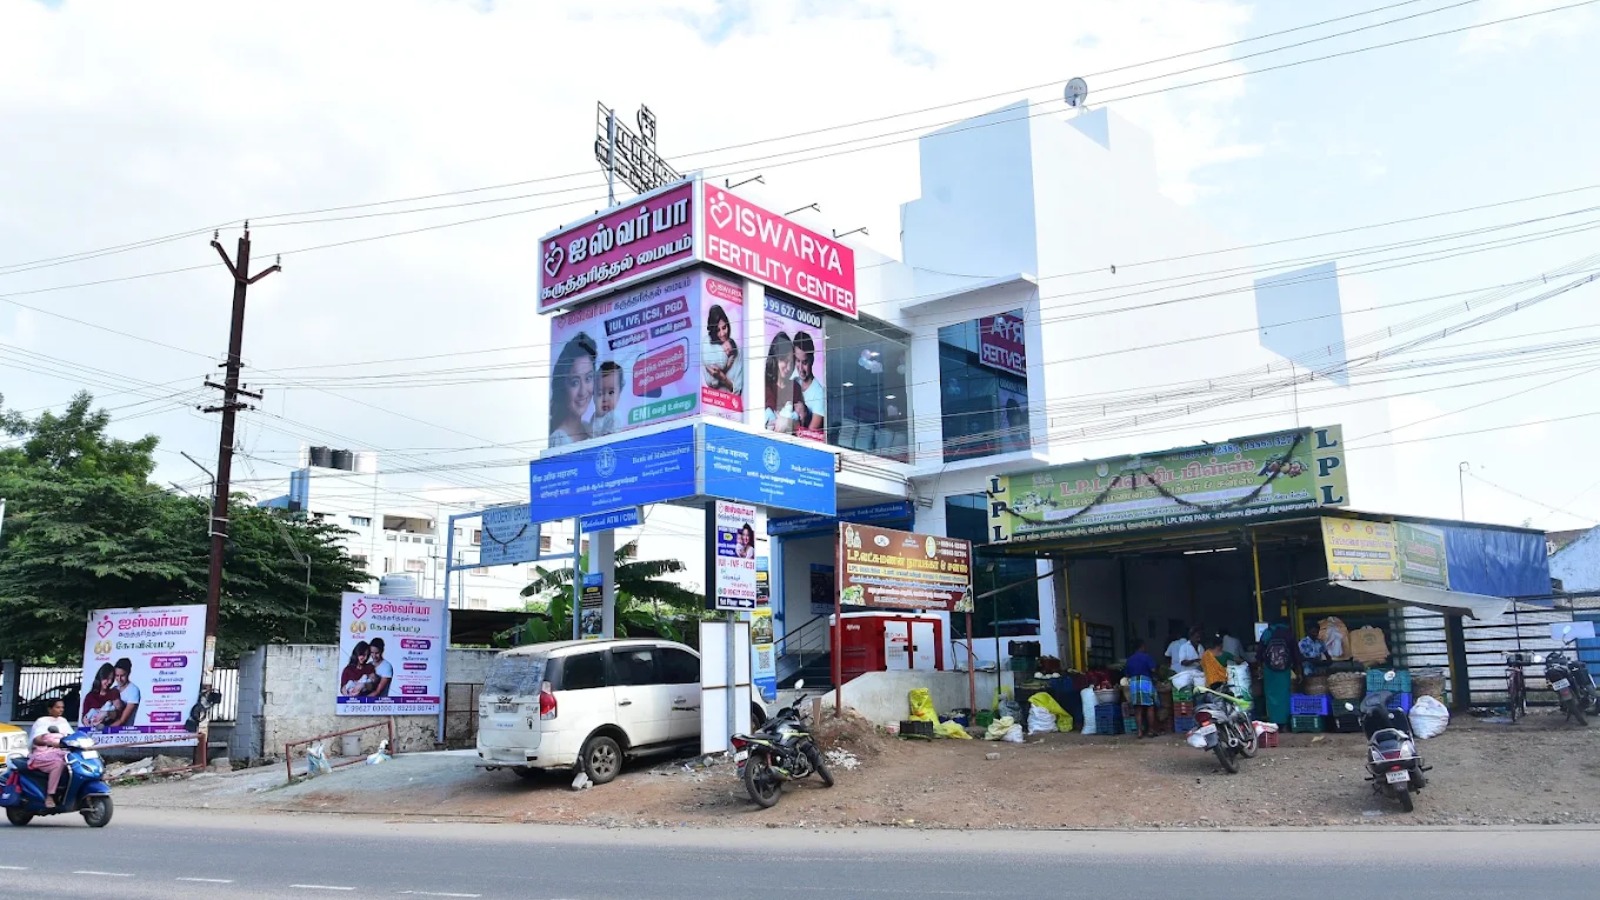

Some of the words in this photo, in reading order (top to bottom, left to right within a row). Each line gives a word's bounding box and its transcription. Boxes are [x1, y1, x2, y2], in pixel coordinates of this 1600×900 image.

[568, 197, 689, 264] ஐஸ்வர்யா
[735, 203, 843, 276] ISWARYA
[541, 258, 634, 301] கருத்தரித்தல்
[637, 233, 692, 266] மையம்
[707, 234, 791, 285] FERTILITY
[796, 271, 855, 312] CENTER
[625, 315, 641, 328] IVF,
[643, 308, 662, 322] ICSI,
[664, 301, 683, 314] PGD
[781, 303, 795, 318] 627
[797, 308, 821, 327] 00000
[632, 406, 651, 421] EMI
[1314, 429, 1344, 505] LPL
[1194, 512, 1211, 521] PARK
[371, 601, 431, 615] ஐஸ்வர்யா
[118, 613, 189, 630] ஐஸ்வர்யா
[115, 639, 176, 651] கோவில்பட்டி
